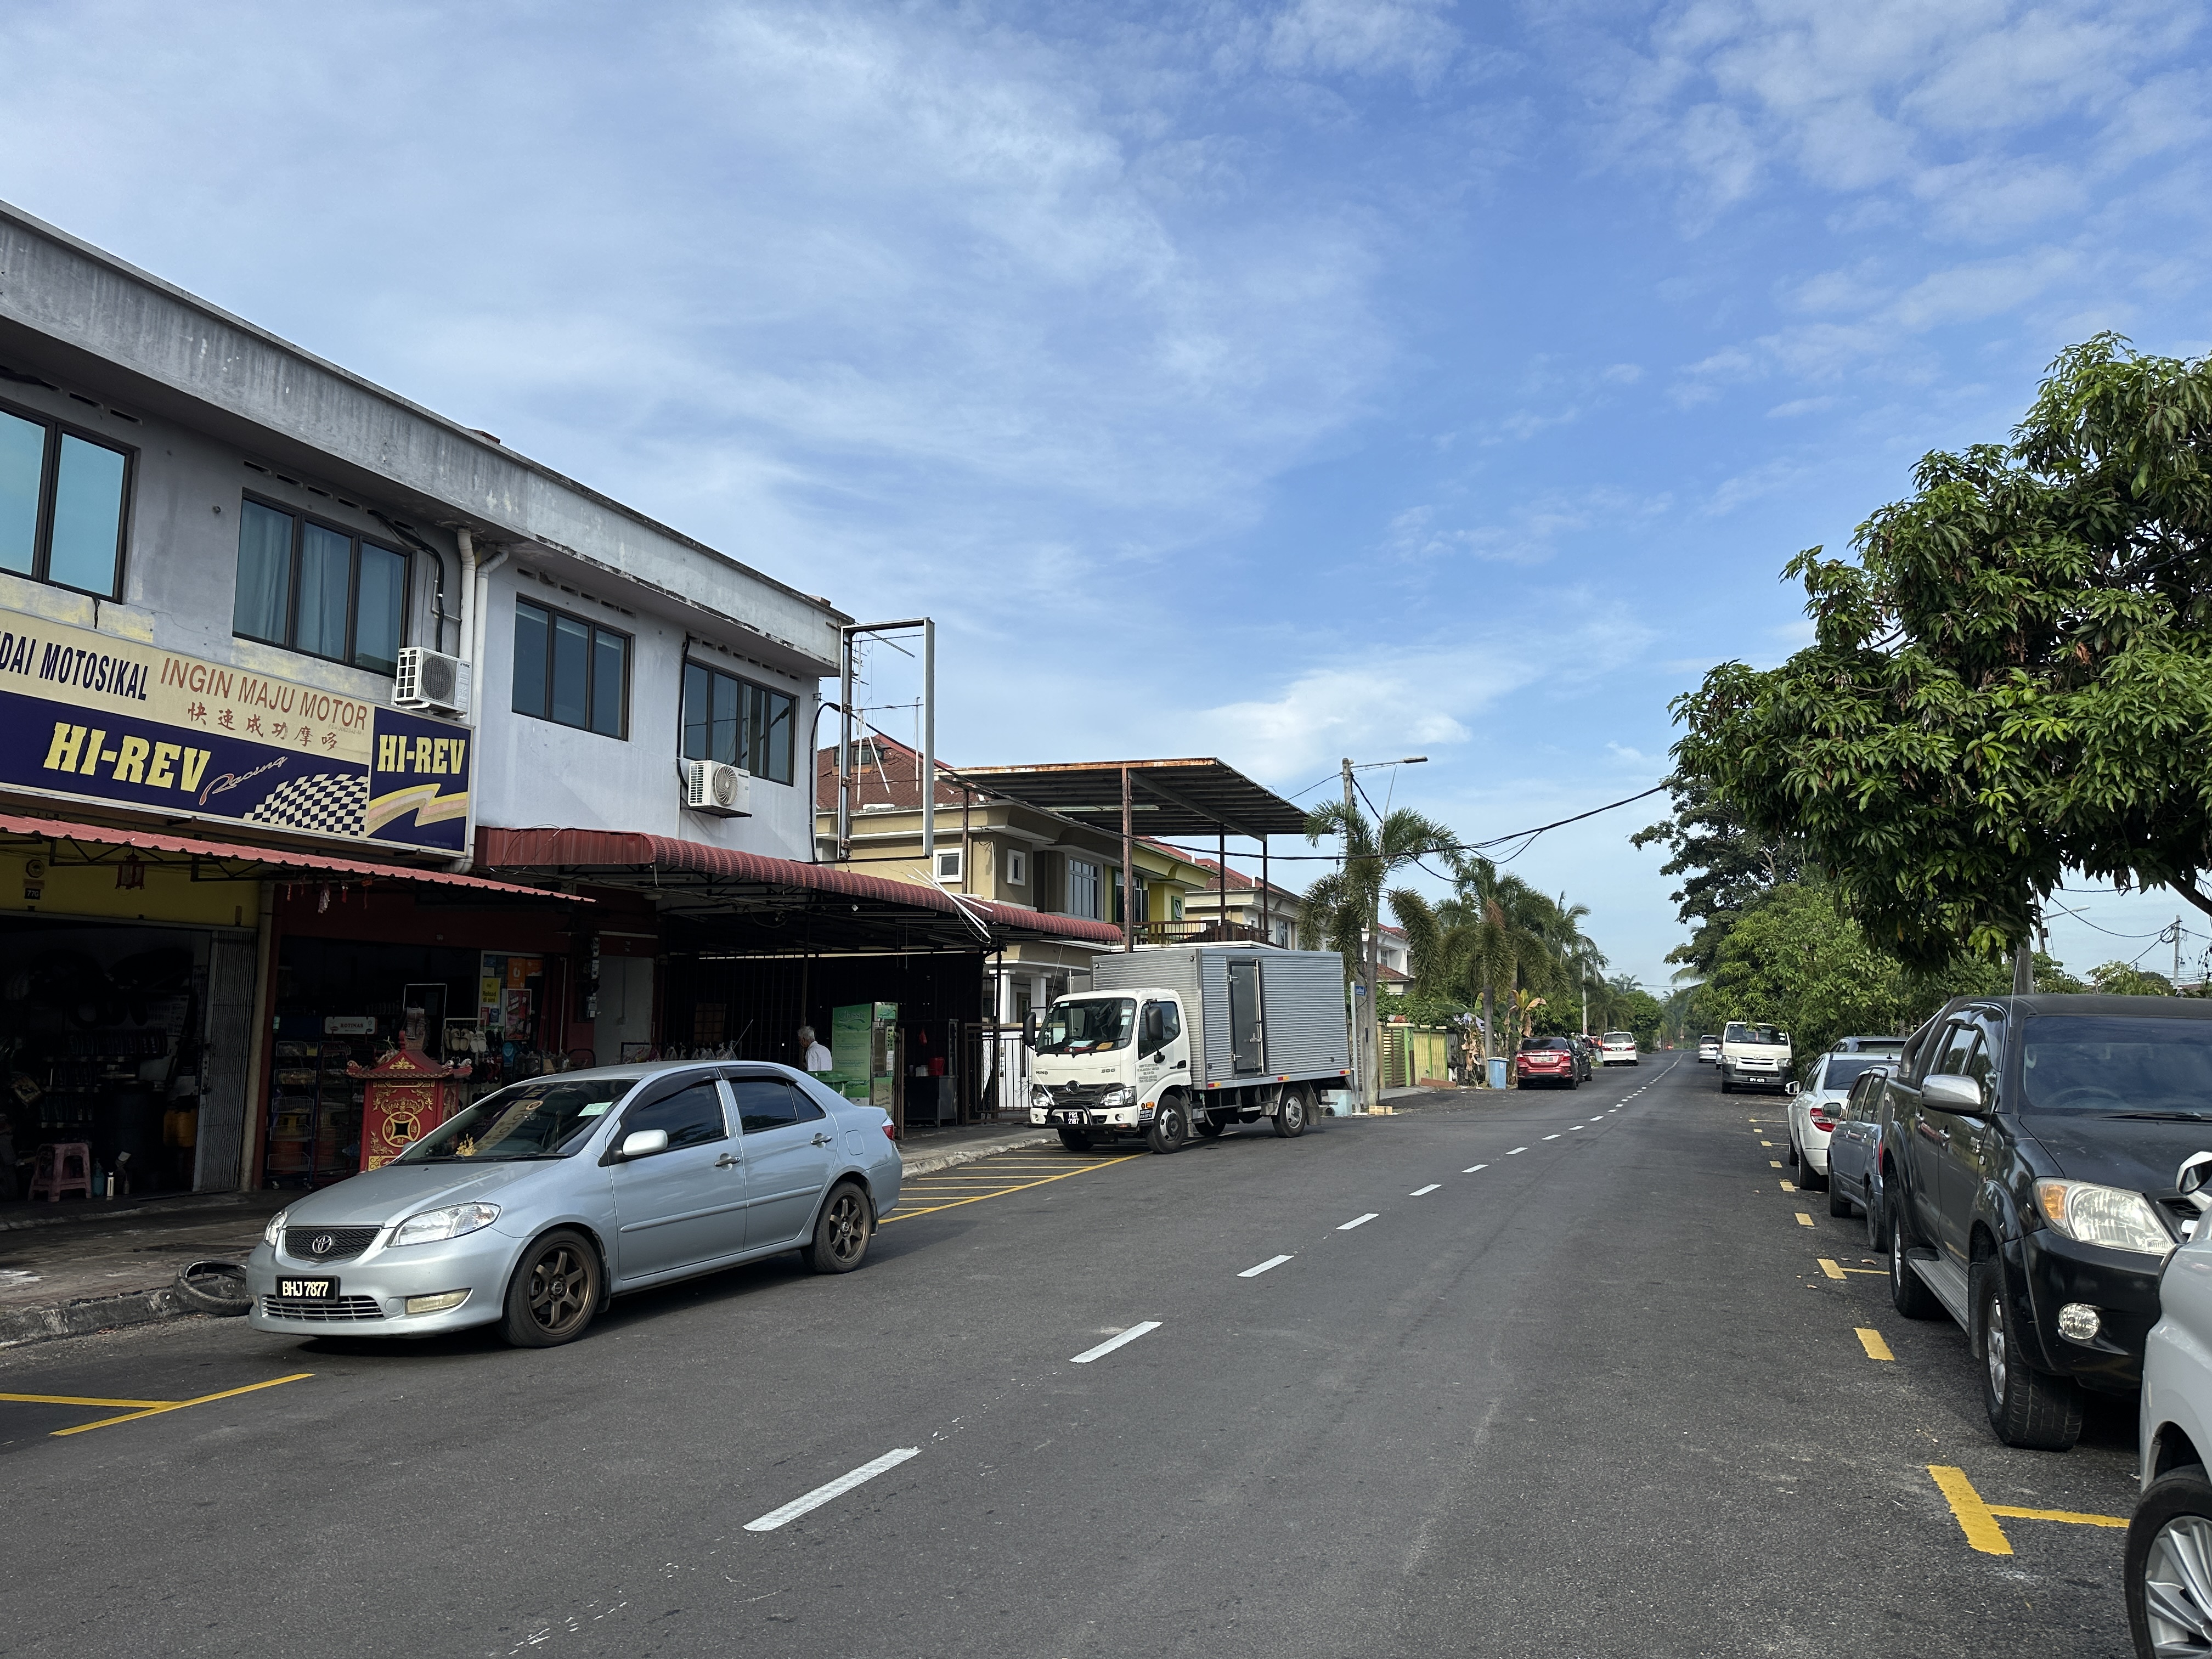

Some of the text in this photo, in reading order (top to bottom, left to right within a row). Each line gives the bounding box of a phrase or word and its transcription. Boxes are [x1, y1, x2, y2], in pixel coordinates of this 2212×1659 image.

[0, 631, 148, 701] DAI MOTOSIKAL
[160, 657, 368, 730] INGIN MAJU MOTOR
[188, 702, 337, 751] 快速成功摩哆
[43, 721, 211, 792] HI-REV
[377, 734, 465, 774] HI-REV
[199, 755, 288, 805] Racing
[839, 1010, 866, 1019] Classic
[282, 1280, 329, 1297] BHJ 7877
